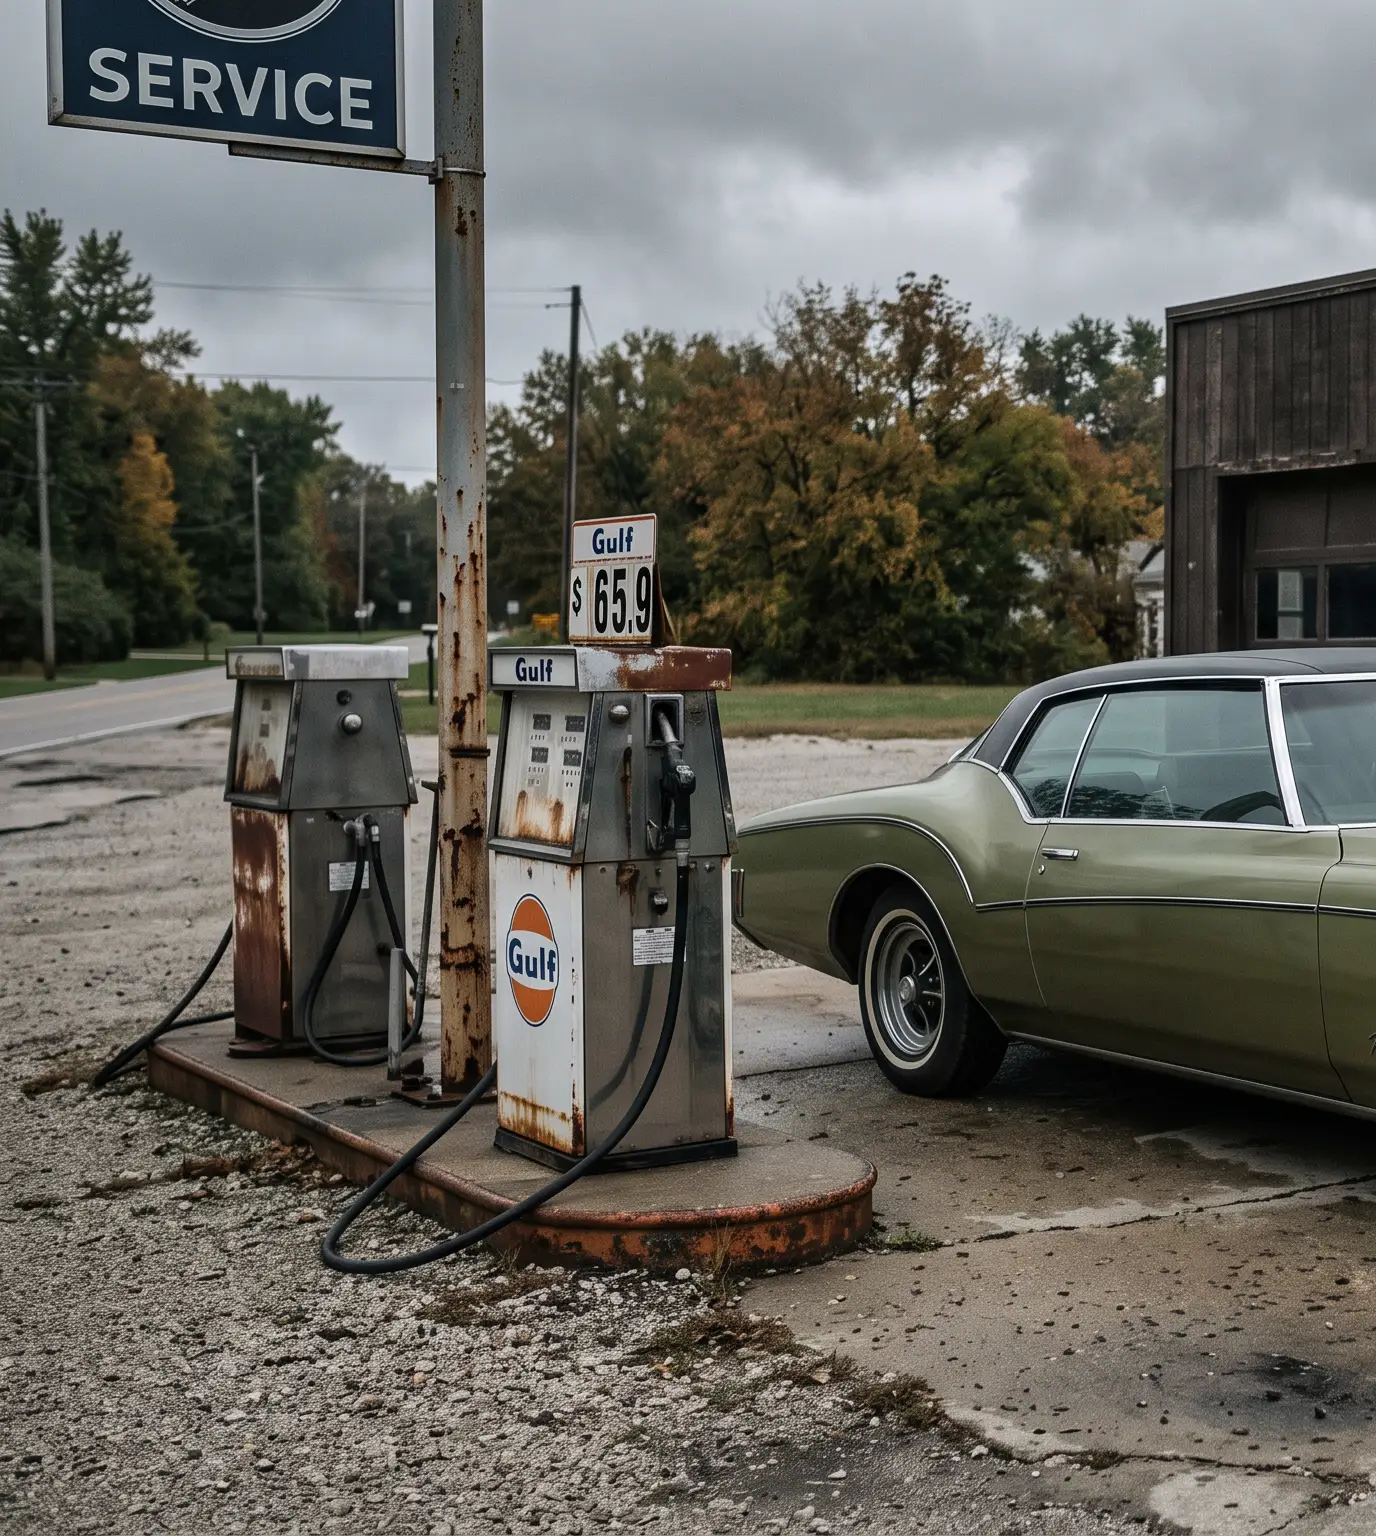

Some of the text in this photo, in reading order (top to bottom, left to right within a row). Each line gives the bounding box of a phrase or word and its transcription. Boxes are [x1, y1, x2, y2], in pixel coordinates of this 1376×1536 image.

[89, 47, 373, 130] SERVICE
[592, 526, 633, 555] Gulf
[594, 566, 652, 634] 65.9
[515, 656, 553, 682] Gulf
[508, 937, 556, 983] Gulf
